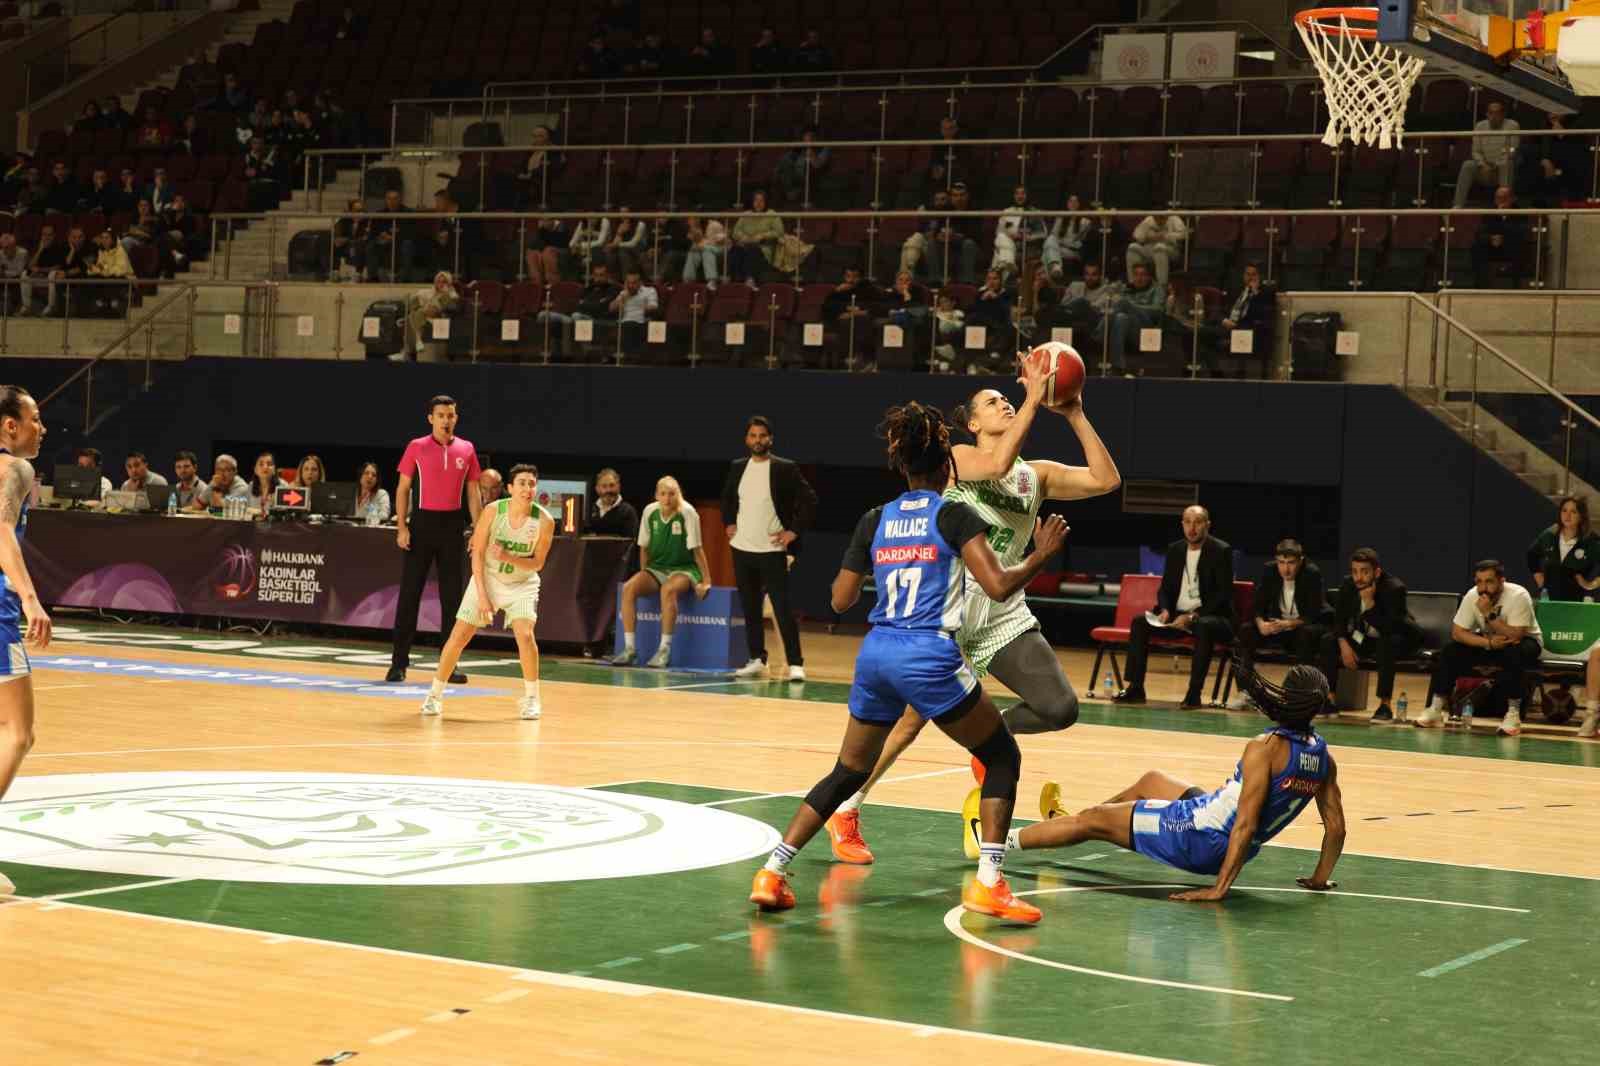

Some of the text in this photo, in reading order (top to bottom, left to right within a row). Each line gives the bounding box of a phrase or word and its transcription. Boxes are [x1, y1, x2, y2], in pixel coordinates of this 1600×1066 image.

[885, 518, 928, 538] WALLACE
[272, 551, 325, 565] HALKBANK
[876, 548, 935, 562] DARDANEL
[259, 566, 316, 580] KADINLAR
[258, 578, 323, 593] BASKETBOL
[885, 567, 922, 619] 17
